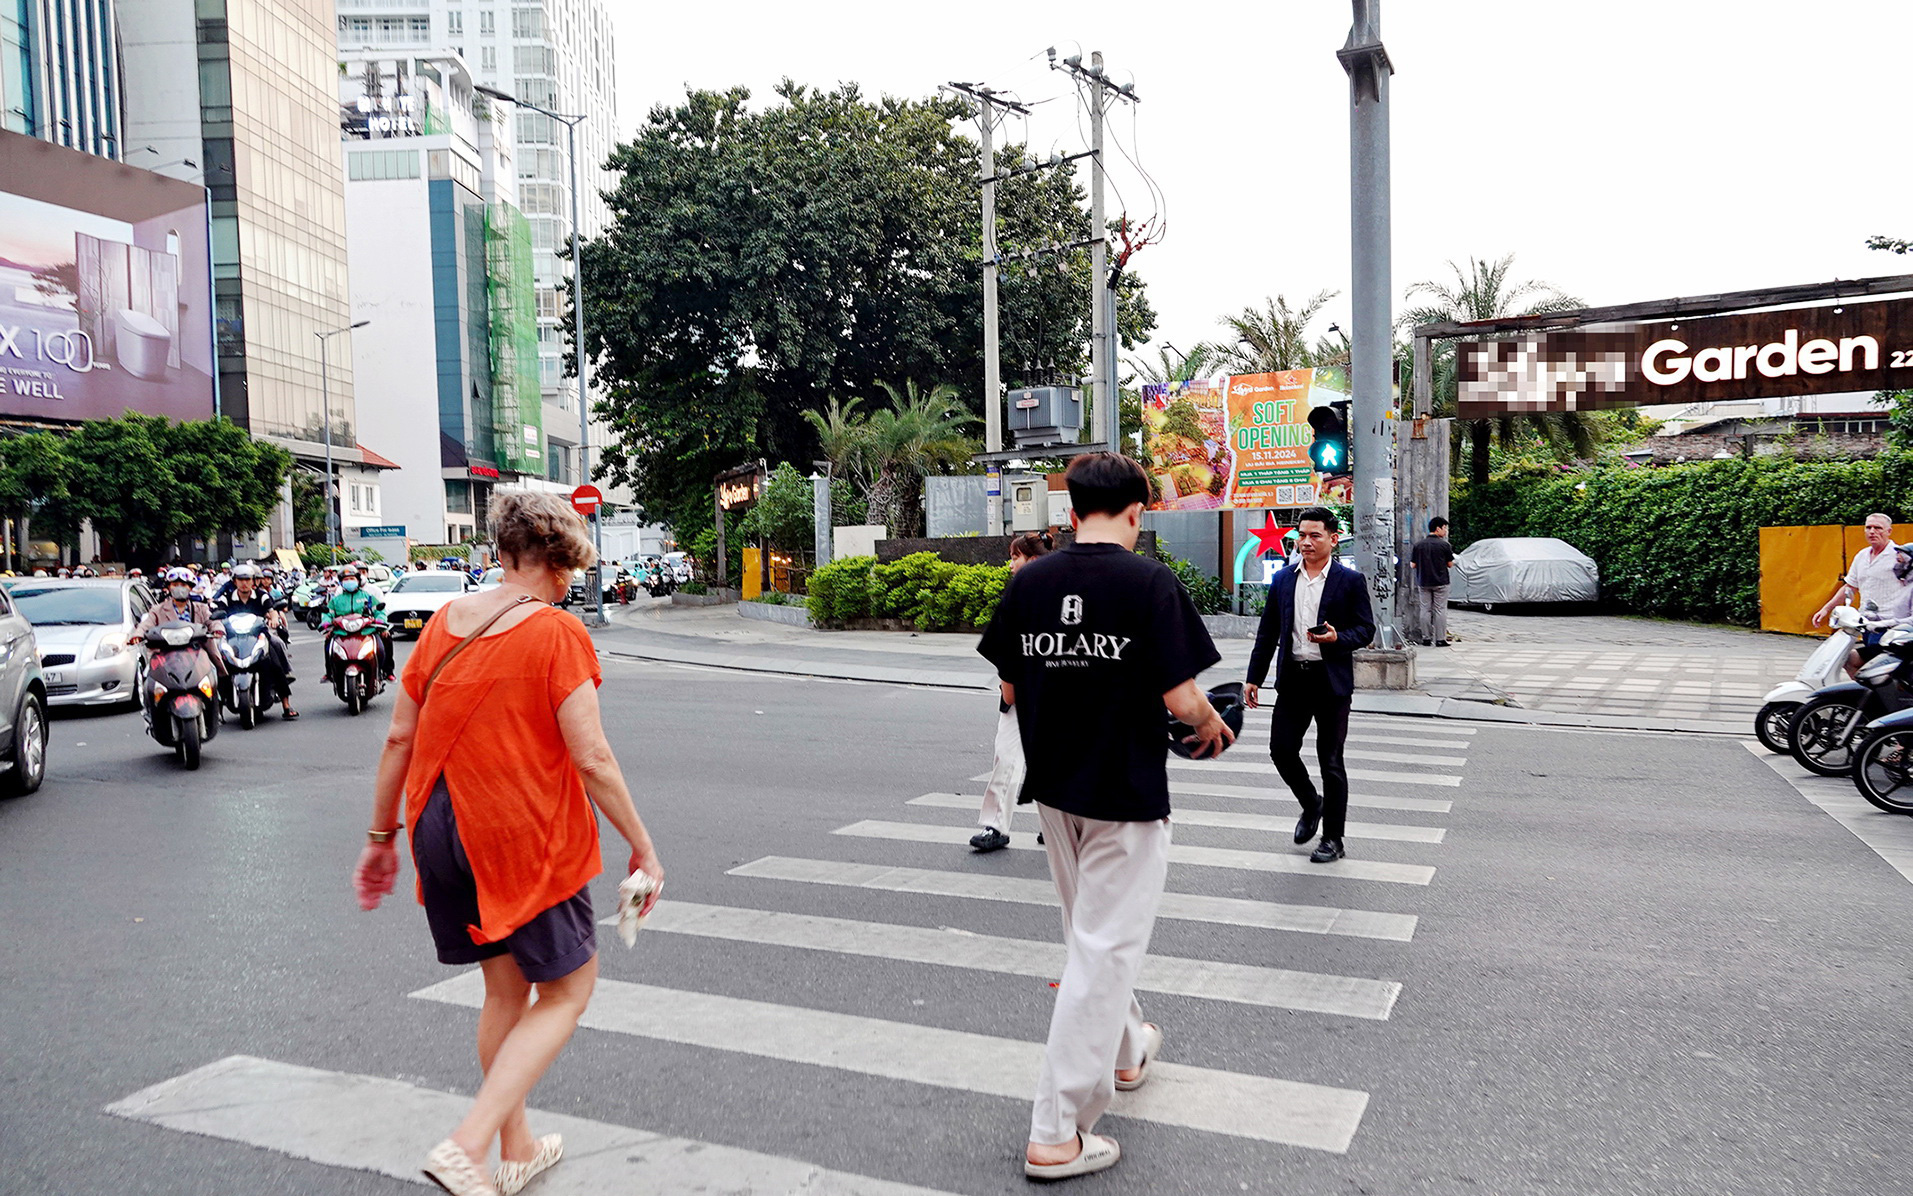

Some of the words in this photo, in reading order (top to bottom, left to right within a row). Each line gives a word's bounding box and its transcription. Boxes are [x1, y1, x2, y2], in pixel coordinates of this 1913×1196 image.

[368, 116, 415, 132] HOTEL
[31, 328, 93, 372] 100
[1641, 329, 1879, 385] Garden
[13, 379, 64, 400] WELL
[1253, 399, 1296, 425] SOFT
[1238, 423, 1313, 450] OPENING
[1252, 450, 1296, 460] 15.11.2024
[1020, 632, 1131, 660] HOLARY
